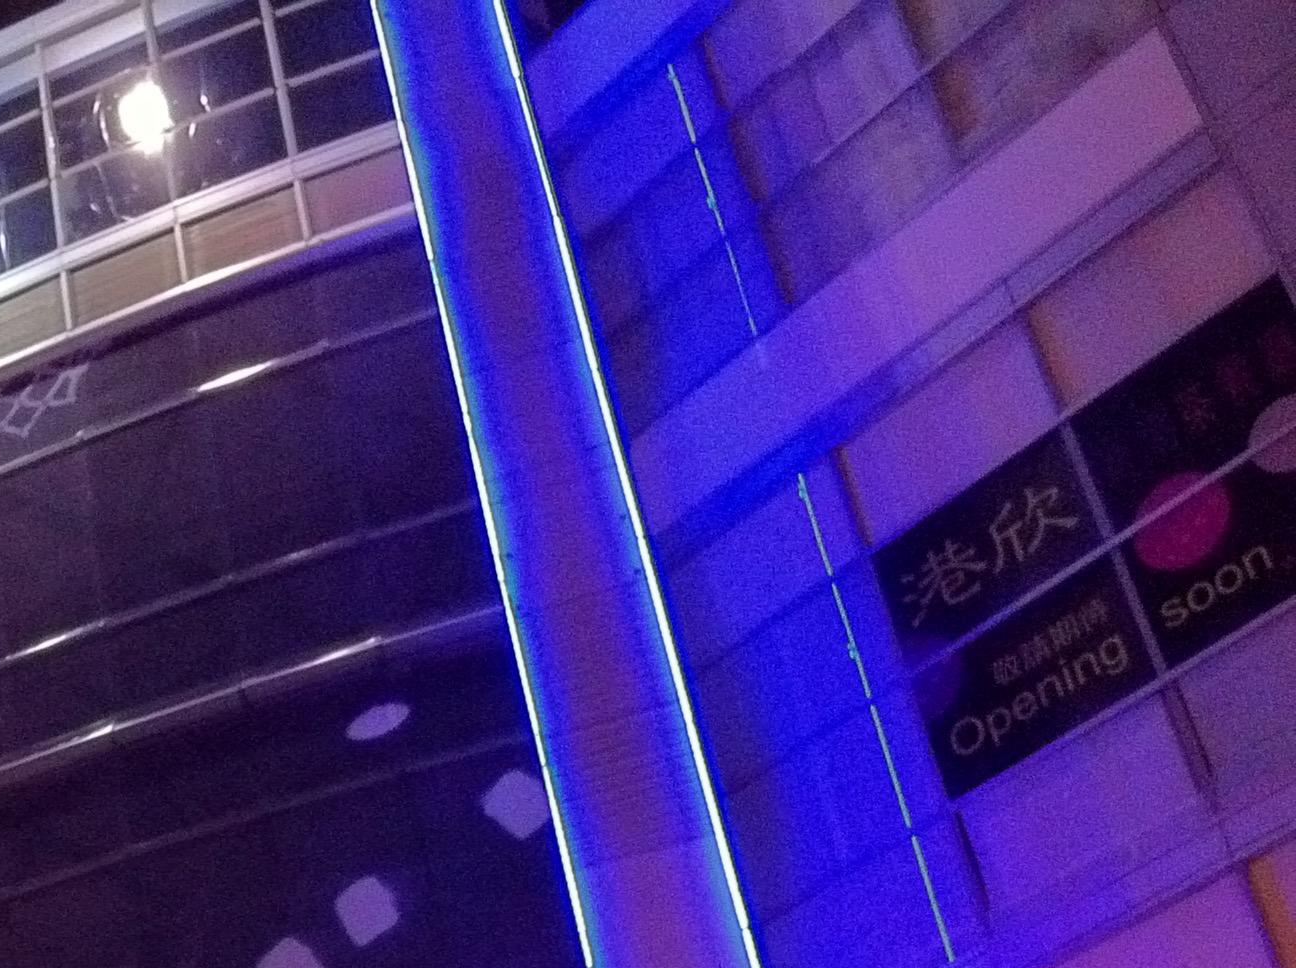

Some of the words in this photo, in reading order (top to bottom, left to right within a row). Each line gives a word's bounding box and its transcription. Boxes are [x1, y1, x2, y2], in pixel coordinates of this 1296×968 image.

[899, 484, 1080, 628] 港欣
[949, 633, 1131, 756] Opening
[1160, 544, 1274, 630] soon
